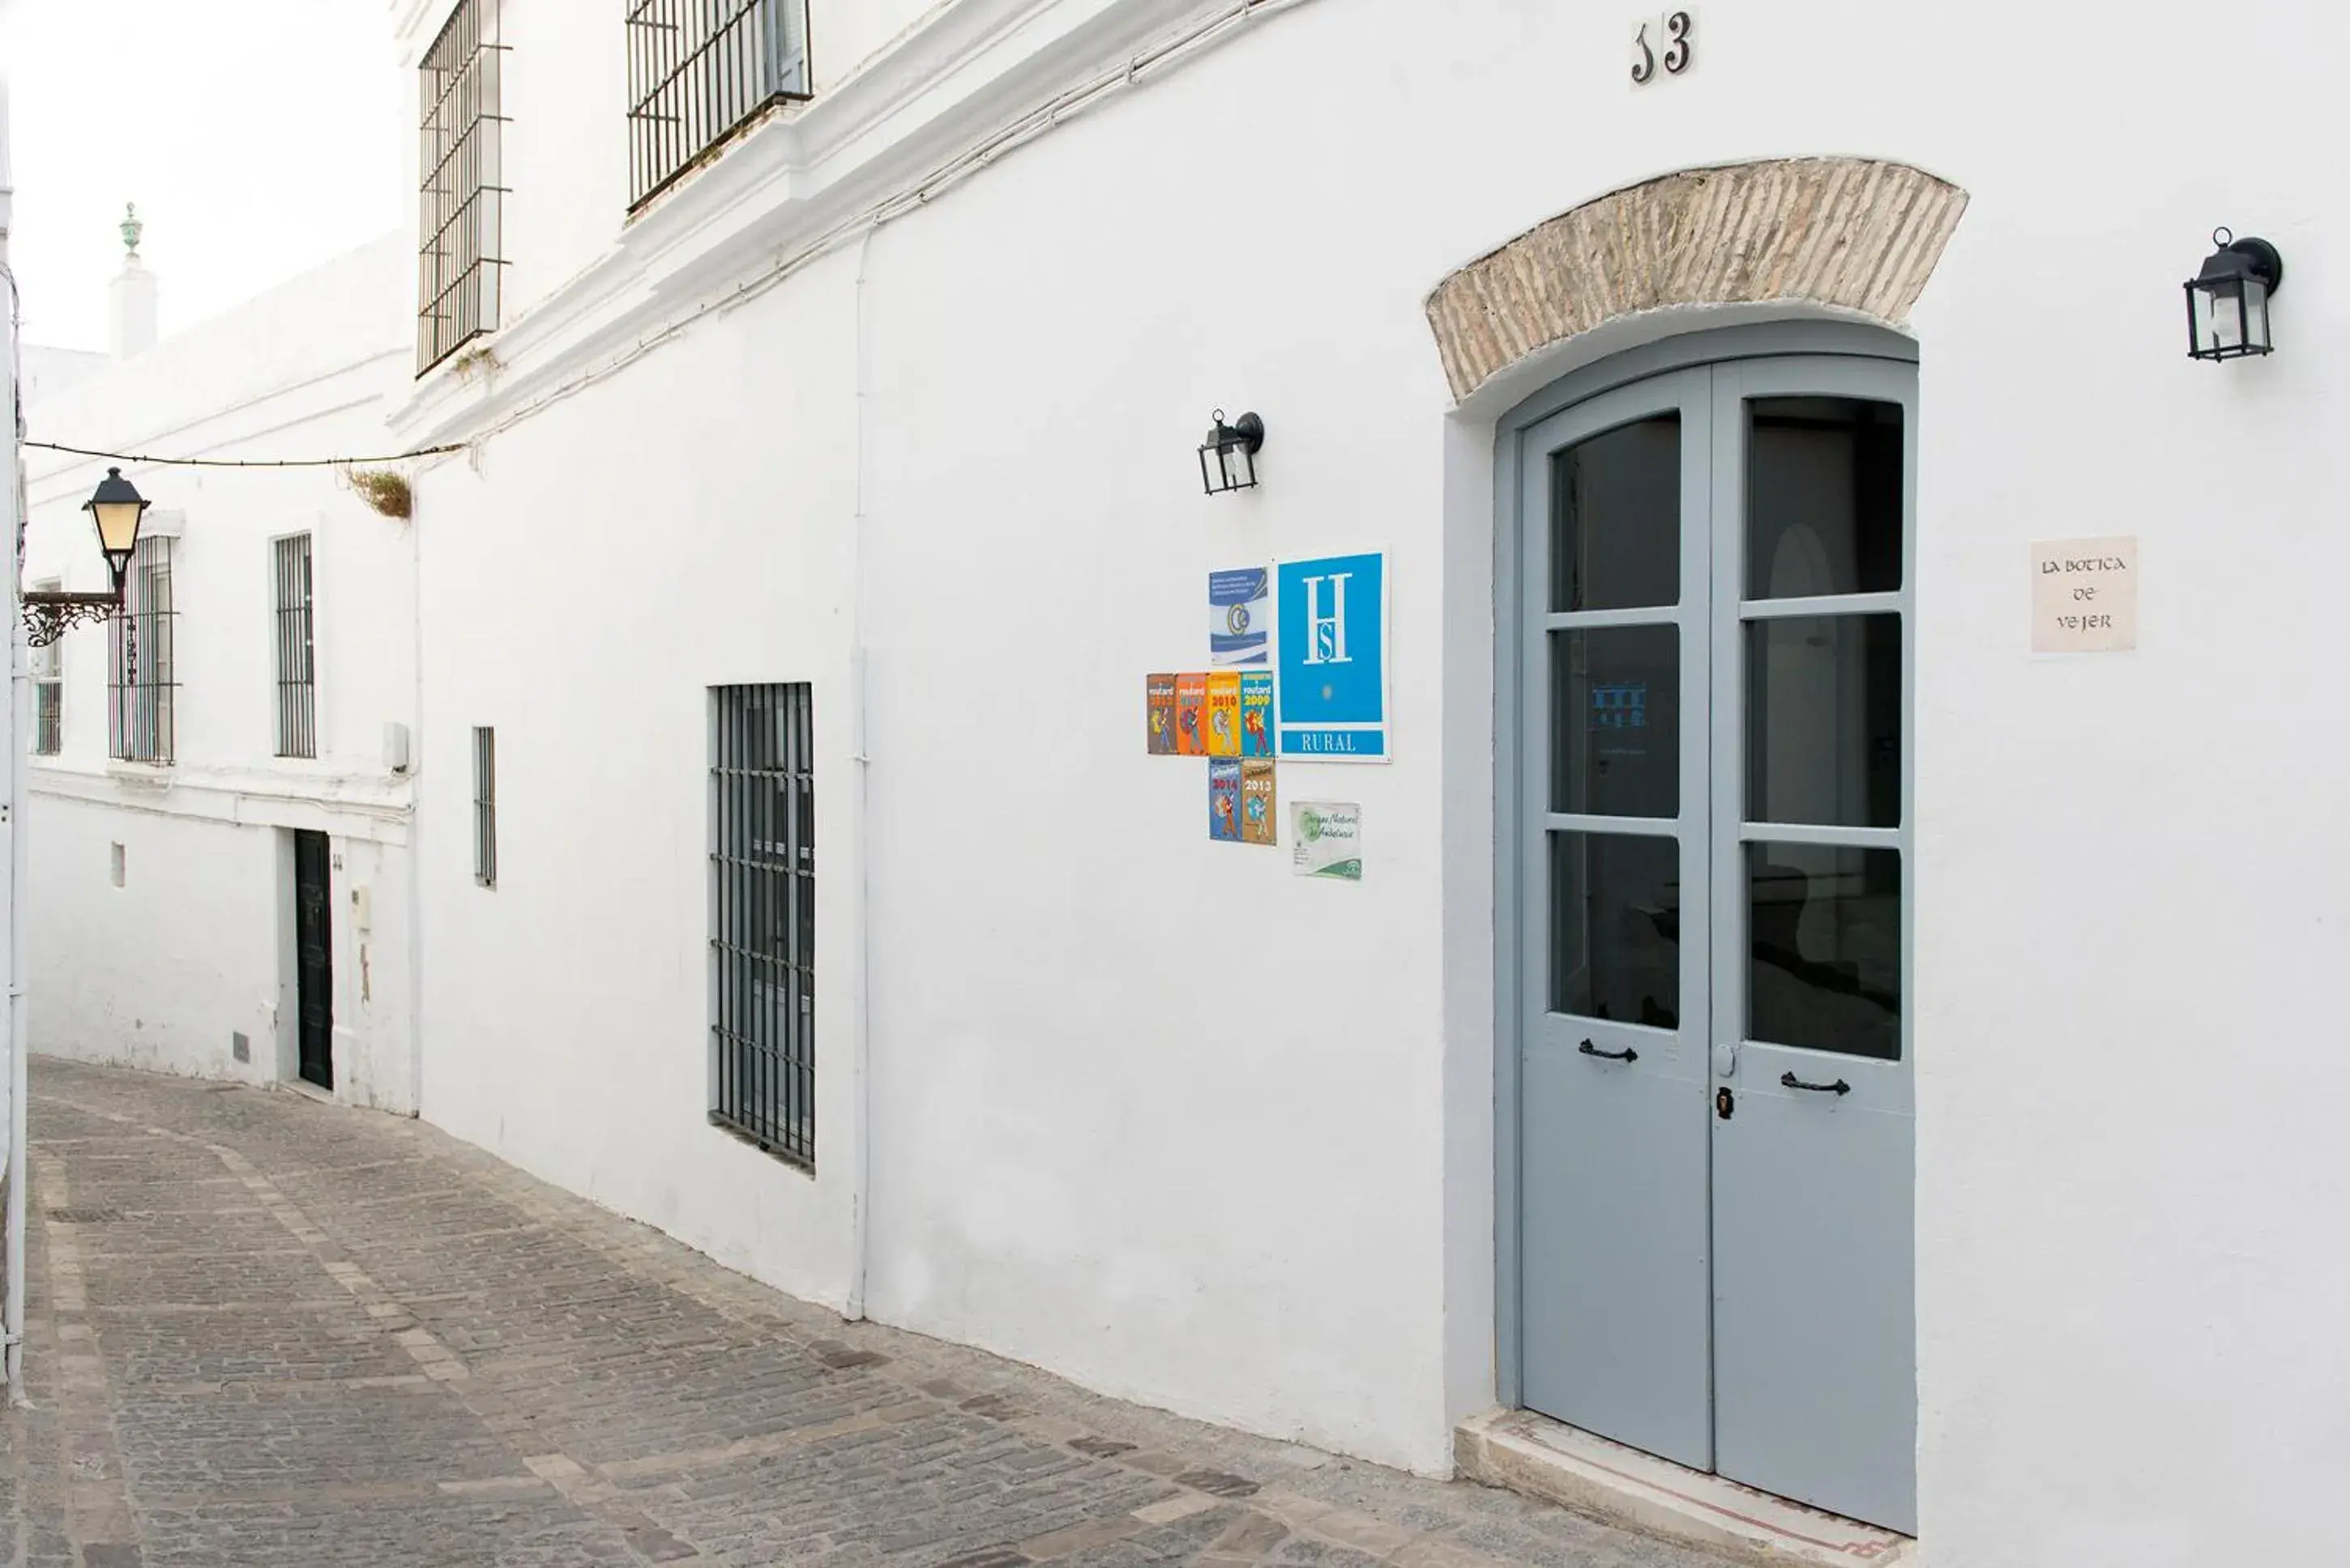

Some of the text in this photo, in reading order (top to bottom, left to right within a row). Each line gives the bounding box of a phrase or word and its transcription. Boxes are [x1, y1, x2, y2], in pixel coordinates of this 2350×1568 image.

[2041, 558, 2127, 575] LA BOTICA
[1211, 696, 1237, 707] 2010
[1244, 694, 1271, 706] 2009
[1301, 733, 1357, 752] RURAL
[1245, 780, 1272, 792] 2013
